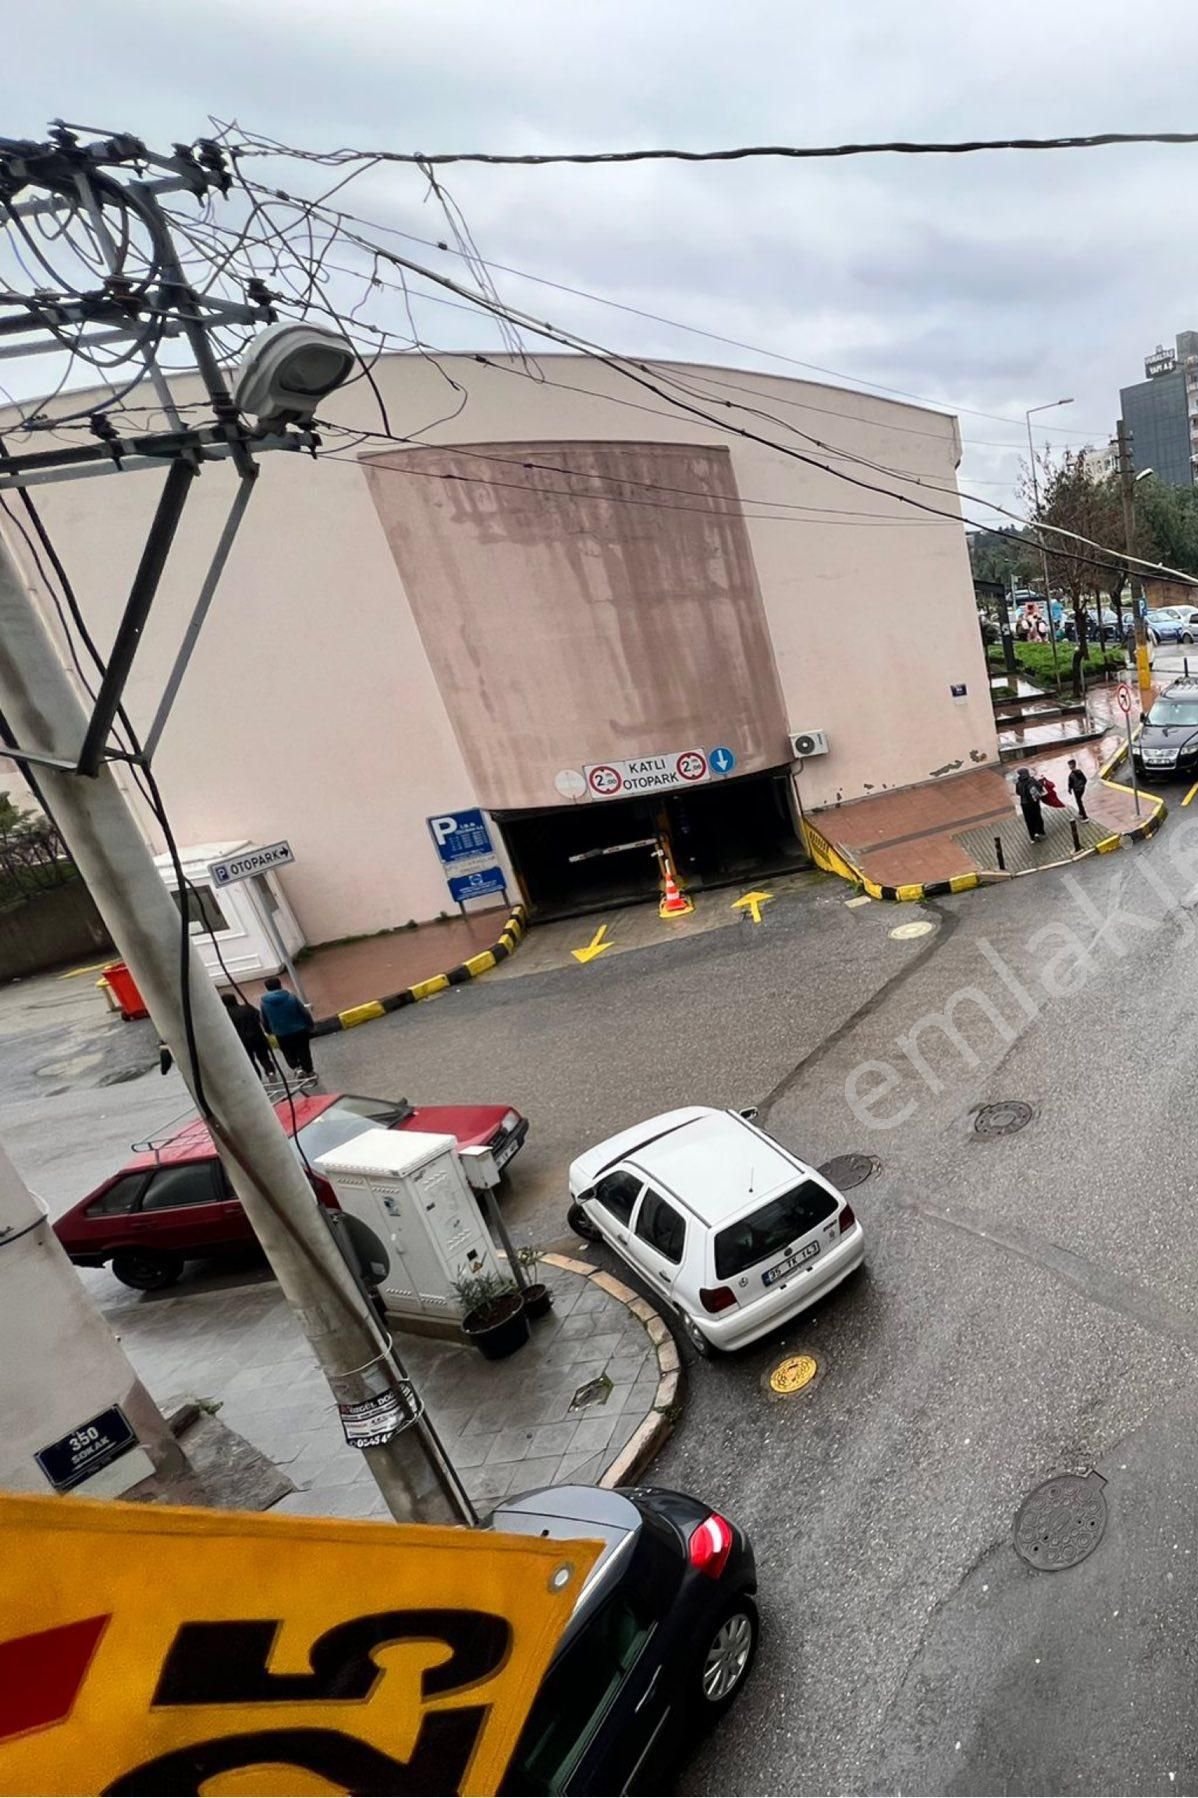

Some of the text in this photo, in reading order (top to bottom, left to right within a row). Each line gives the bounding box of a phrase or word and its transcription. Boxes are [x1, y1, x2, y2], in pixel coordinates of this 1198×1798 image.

[629, 759, 666, 774] KATLI
[623, 772, 680, 791] OTOPARK
[431, 816, 458, 845] P
[230, 850, 281, 875] OTOPARK
[69, 1426, 99, 1452] 350
[71, 1435, 111, 1465] SOKAK
